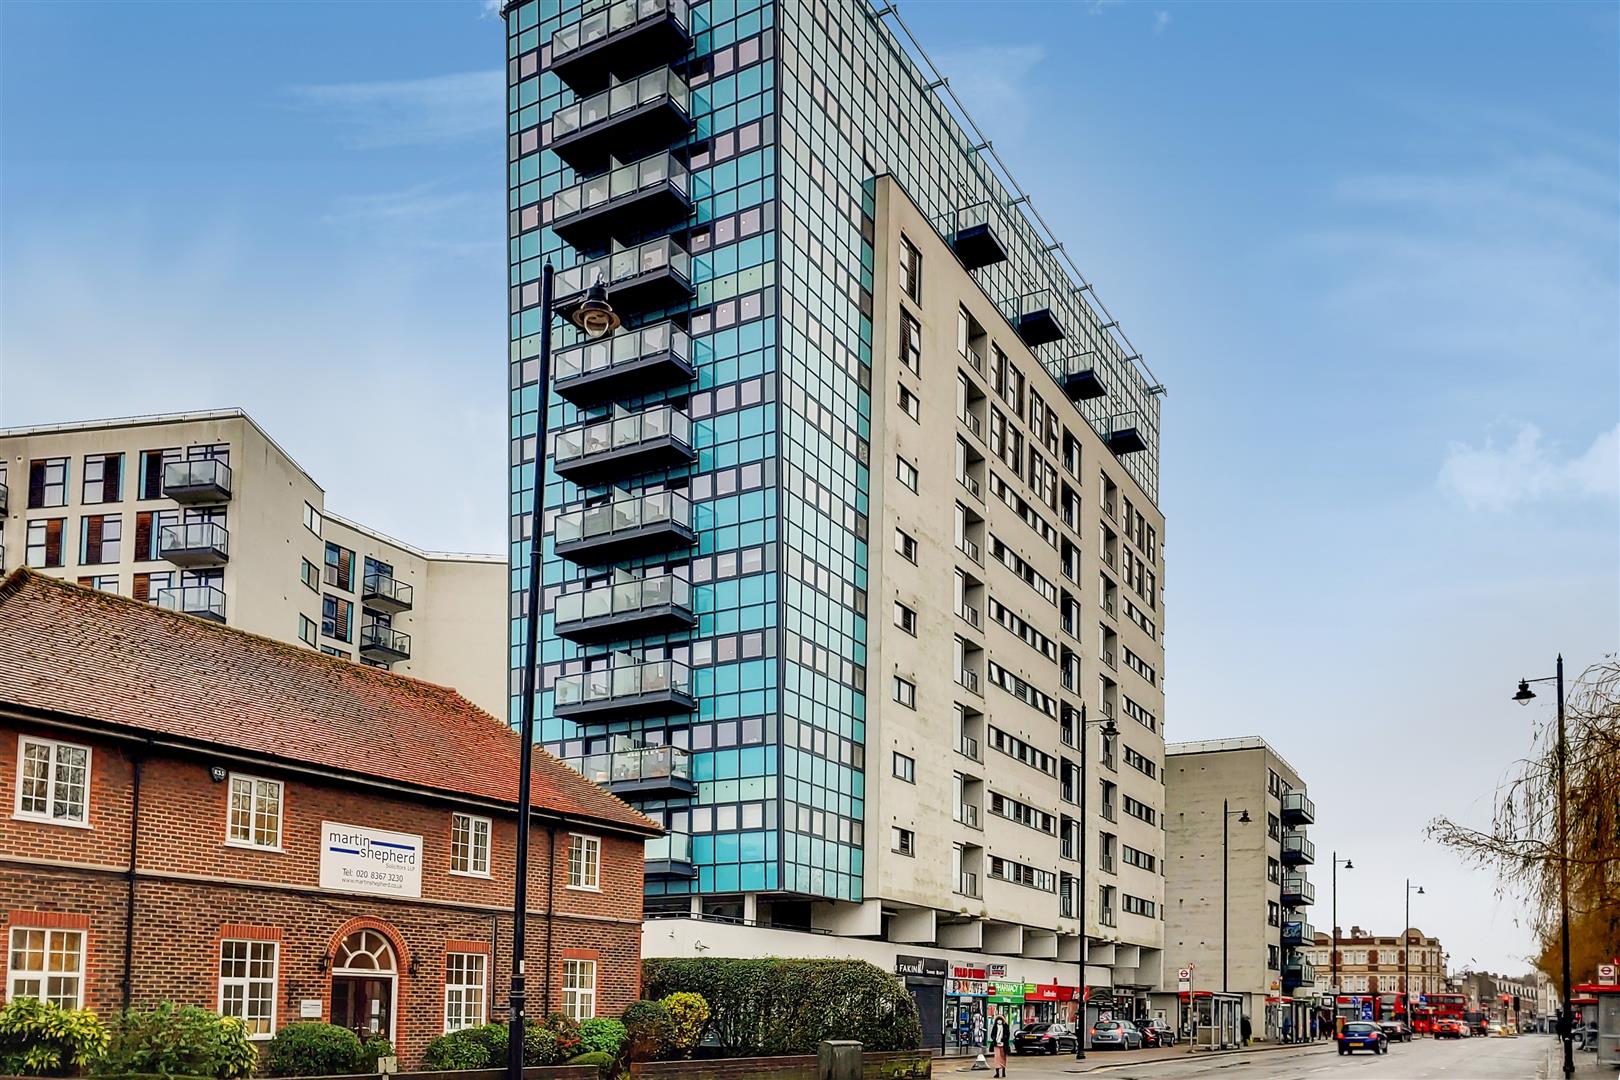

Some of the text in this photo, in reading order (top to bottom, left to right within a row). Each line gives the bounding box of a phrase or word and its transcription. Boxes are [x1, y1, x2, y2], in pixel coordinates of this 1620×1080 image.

[330, 832, 370, 846] martin
[360, 847, 415, 864] shepherd
[356, 869, 369, 878] 020
[370, 871, 386, 880] 8367
[388, 873, 403, 882] 3230
[996, 983, 1019, 992] PHARMACY
